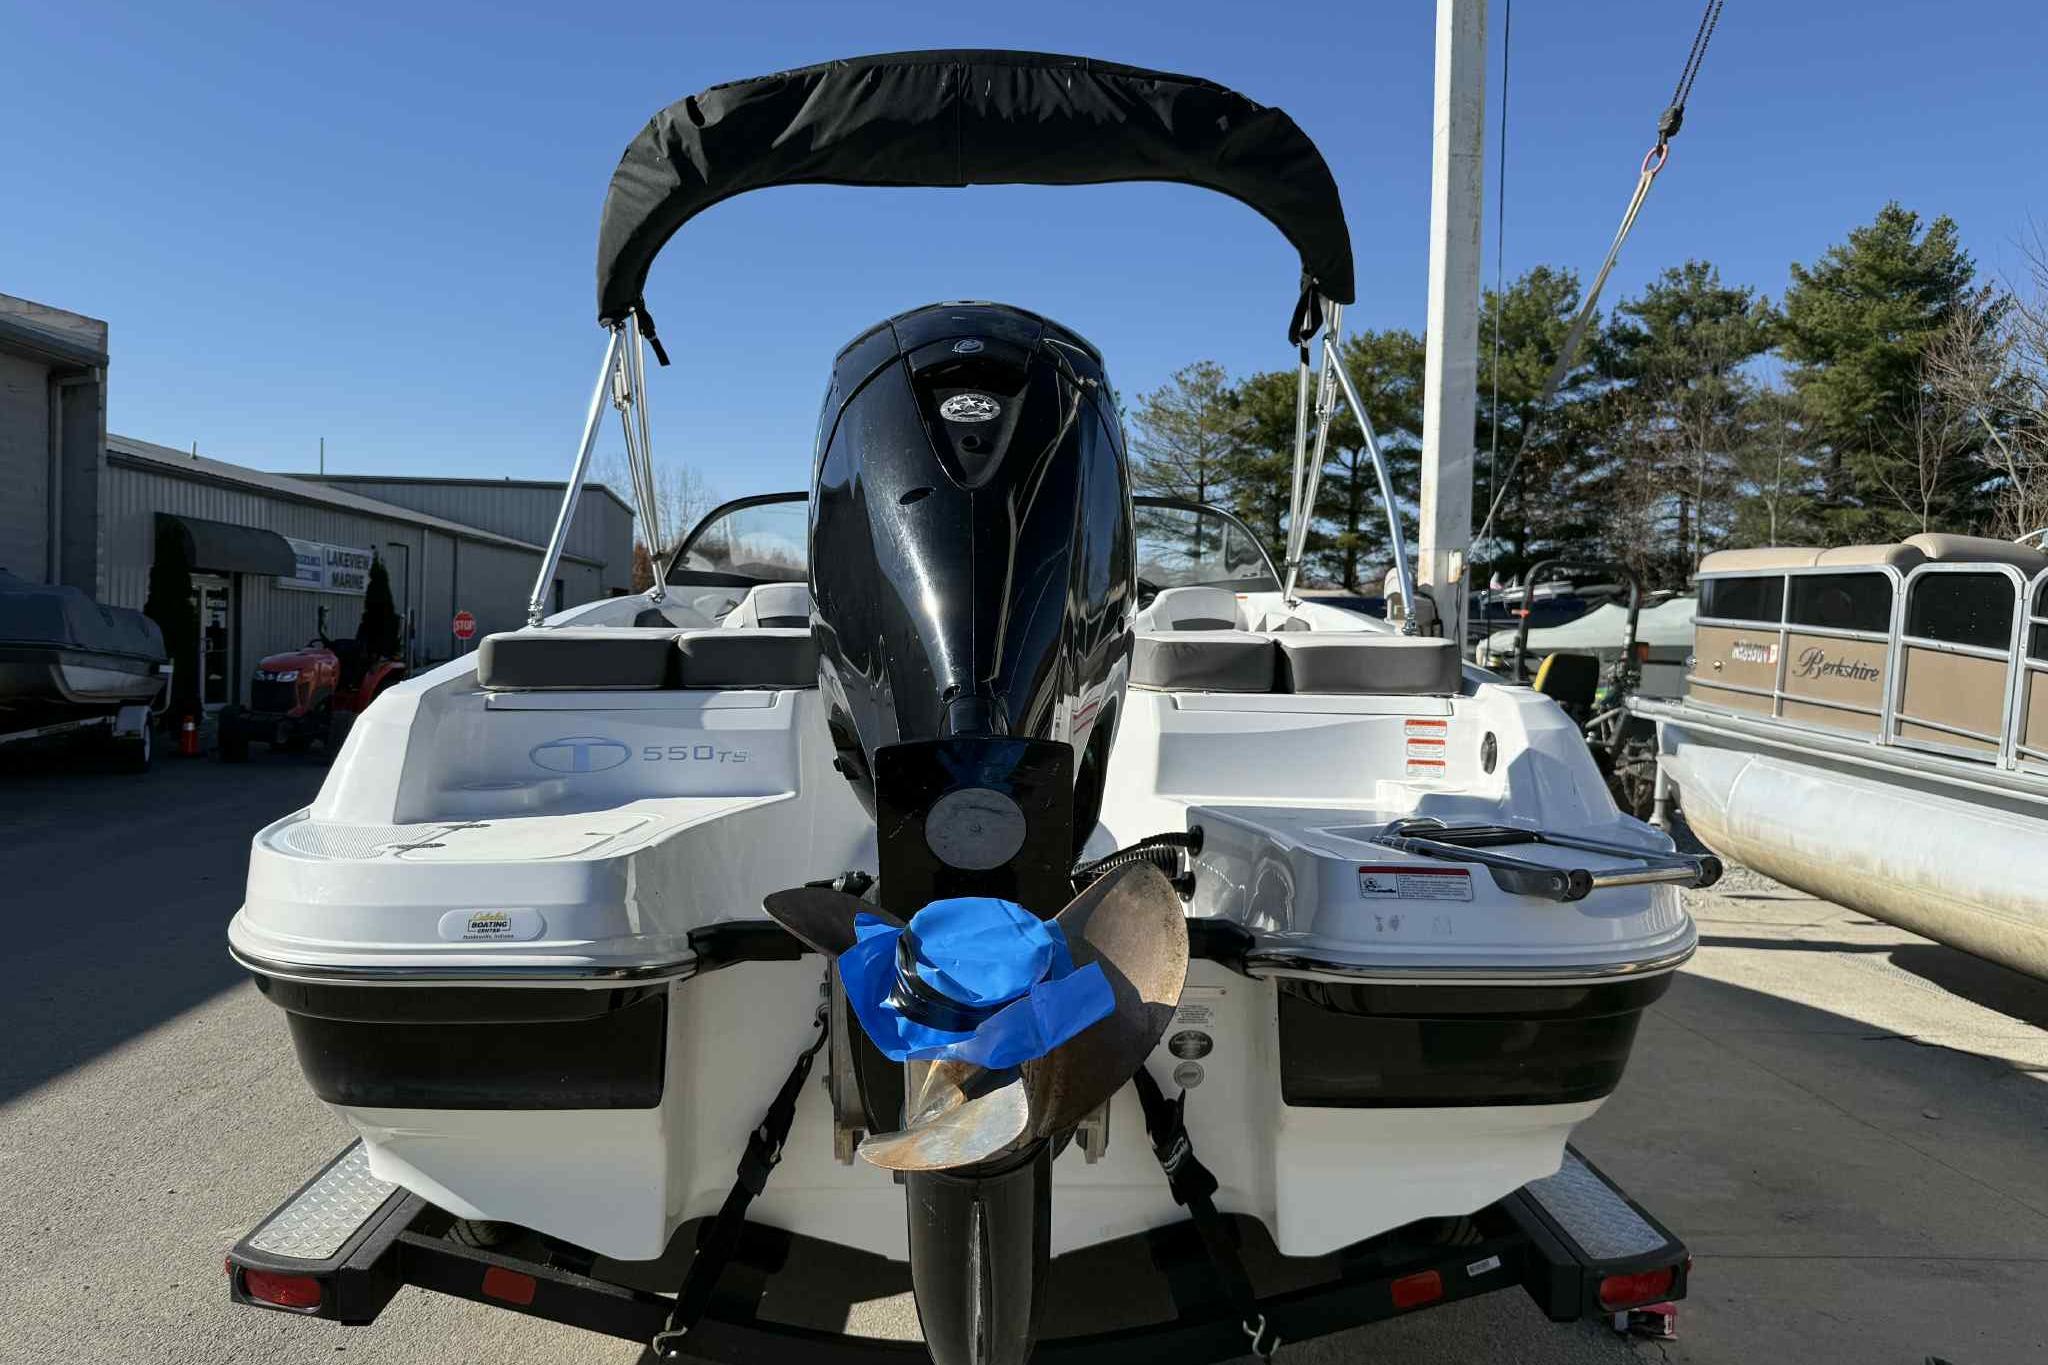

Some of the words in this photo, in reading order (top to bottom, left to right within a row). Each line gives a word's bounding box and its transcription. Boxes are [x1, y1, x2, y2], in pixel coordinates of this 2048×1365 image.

[327, 549, 369, 571] LAKEVIEW
[332, 571, 364, 590] MARINE
[455, 620, 475, 630] STOP
[1792, 646, 1880, 682] Berkshire
[471, 921, 507, 929] BOATING
